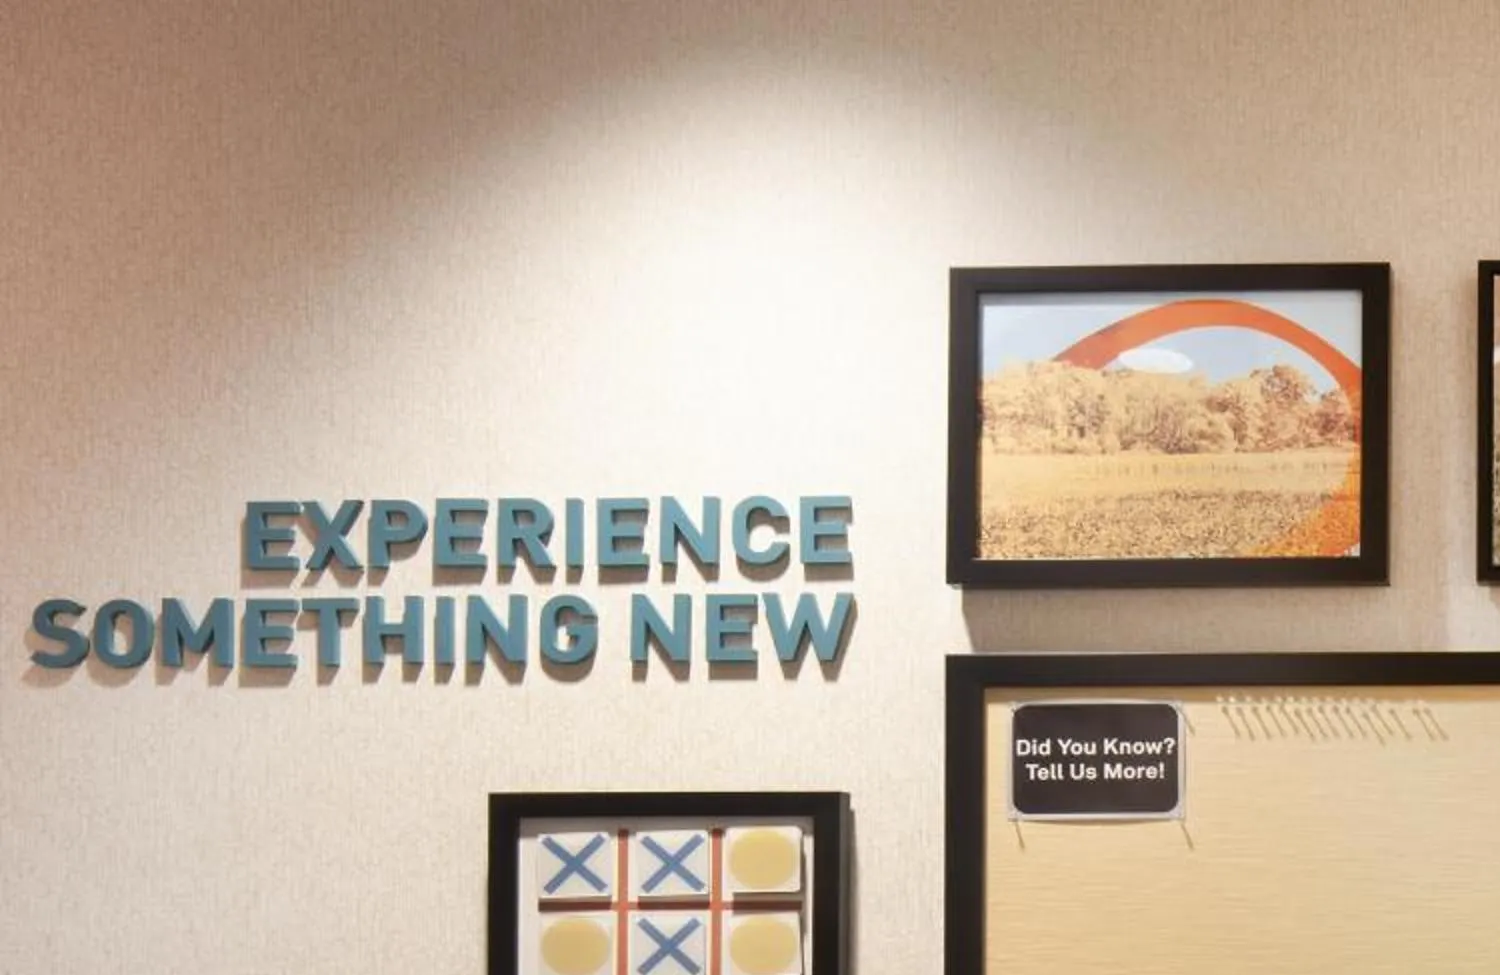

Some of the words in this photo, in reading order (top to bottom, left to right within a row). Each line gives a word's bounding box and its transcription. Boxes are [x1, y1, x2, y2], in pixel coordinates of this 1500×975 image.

[243, 495, 853, 570] EXPERIENCE
[30, 592, 600, 669] SOMETHING
[628, 592, 858, 663] NEW
[1015, 738, 1051, 756] Did
[1057, 738, 1097, 756] You
[1103, 737, 1176, 755] Know?
[1025, 763, 1064, 781] Tell
[1069, 763, 1097, 780] Us
[1103, 762, 1165, 780] More!
